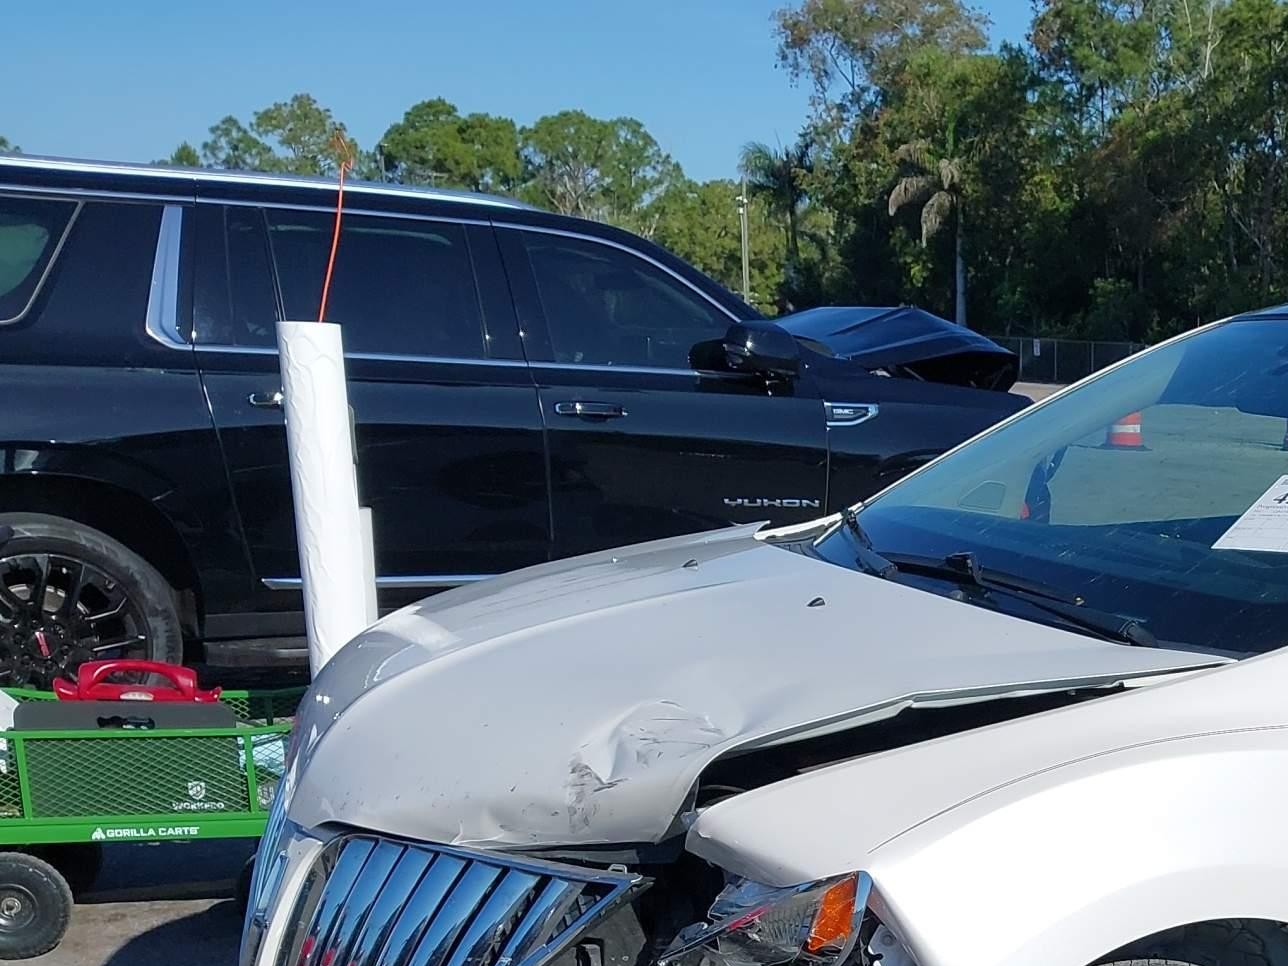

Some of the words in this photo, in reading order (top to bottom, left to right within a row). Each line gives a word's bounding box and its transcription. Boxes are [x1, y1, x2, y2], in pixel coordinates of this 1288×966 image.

[723, 498, 820, 508] YUKON
[106, 828, 156, 838] GORILLA
[158, 826, 198, 836] CARTS
